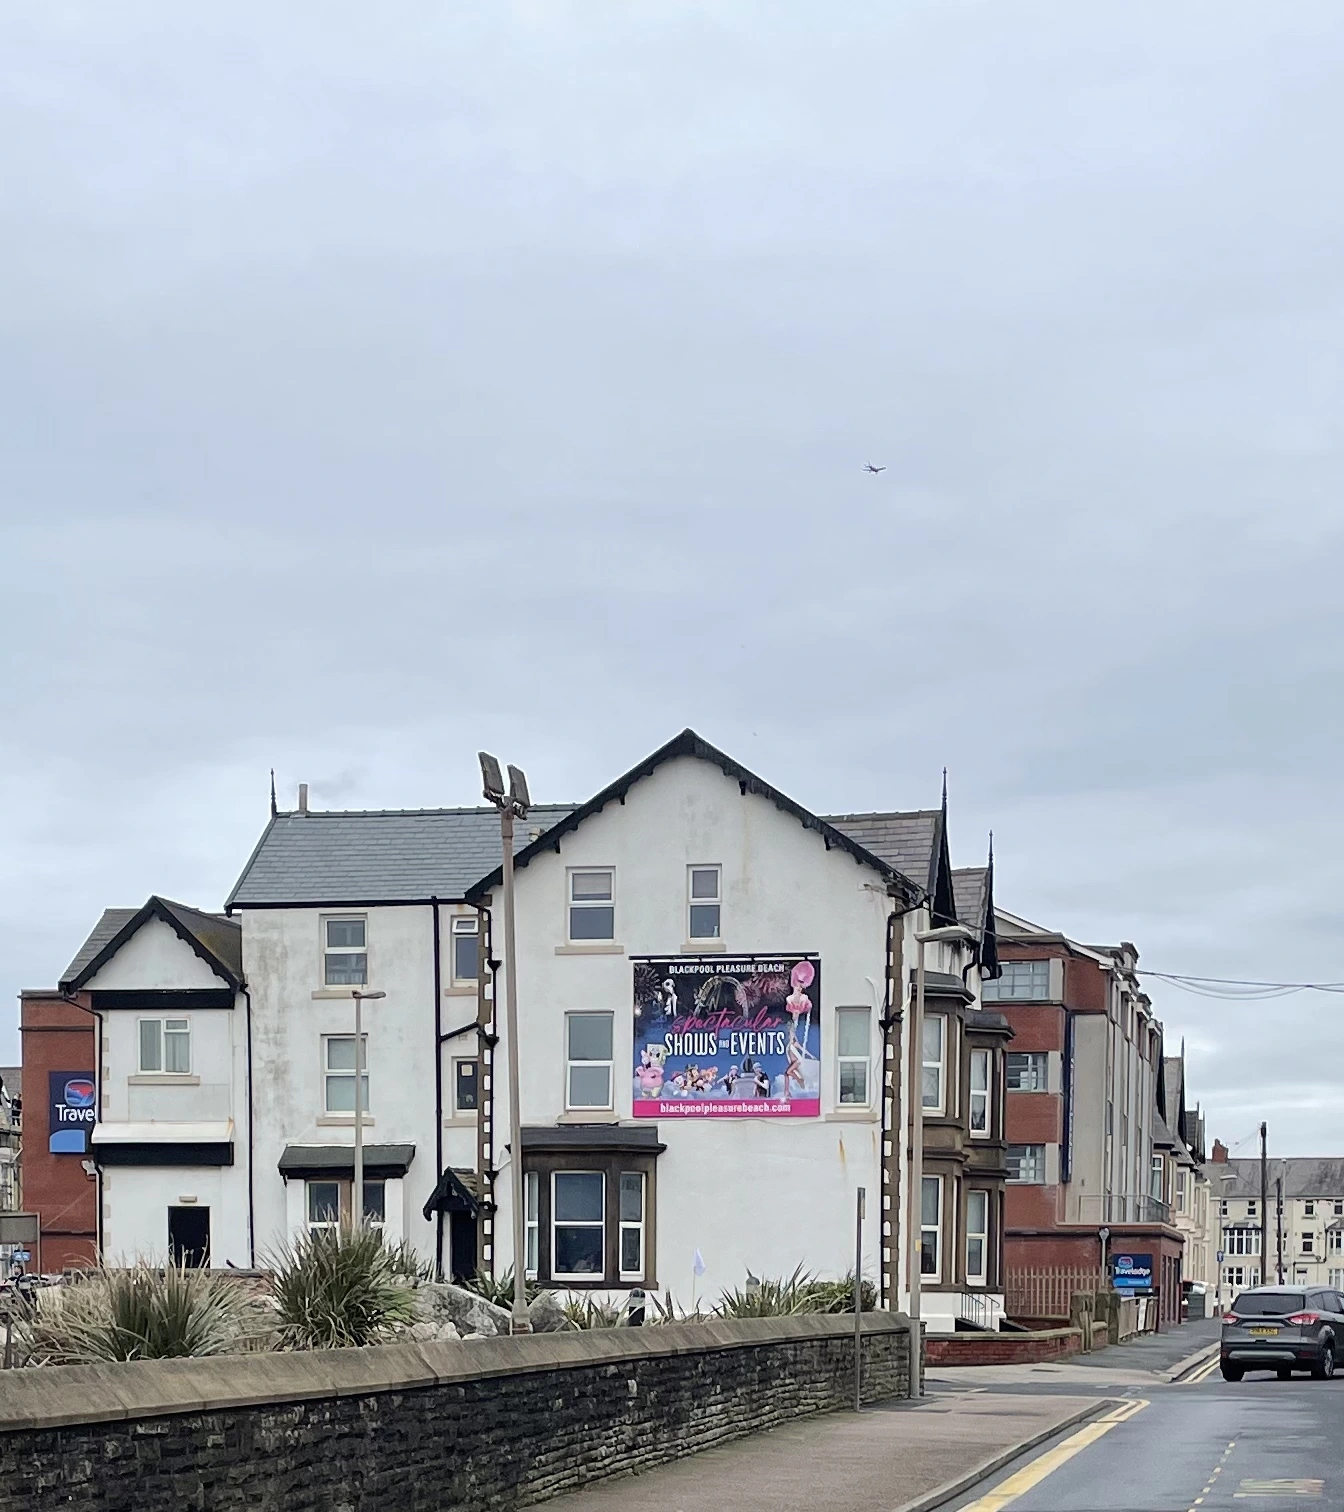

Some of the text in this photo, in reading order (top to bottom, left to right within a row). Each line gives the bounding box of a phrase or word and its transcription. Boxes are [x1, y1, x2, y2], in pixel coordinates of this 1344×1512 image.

[669, 963, 785, 974] BLACKPOOL PLEASURE BEACH
[664, 1032, 717, 1056] SHOWS
[731, 1031, 785, 1055] EVENTS
[660, 1102, 791, 1115] blackpoolpleasurebeach.com
